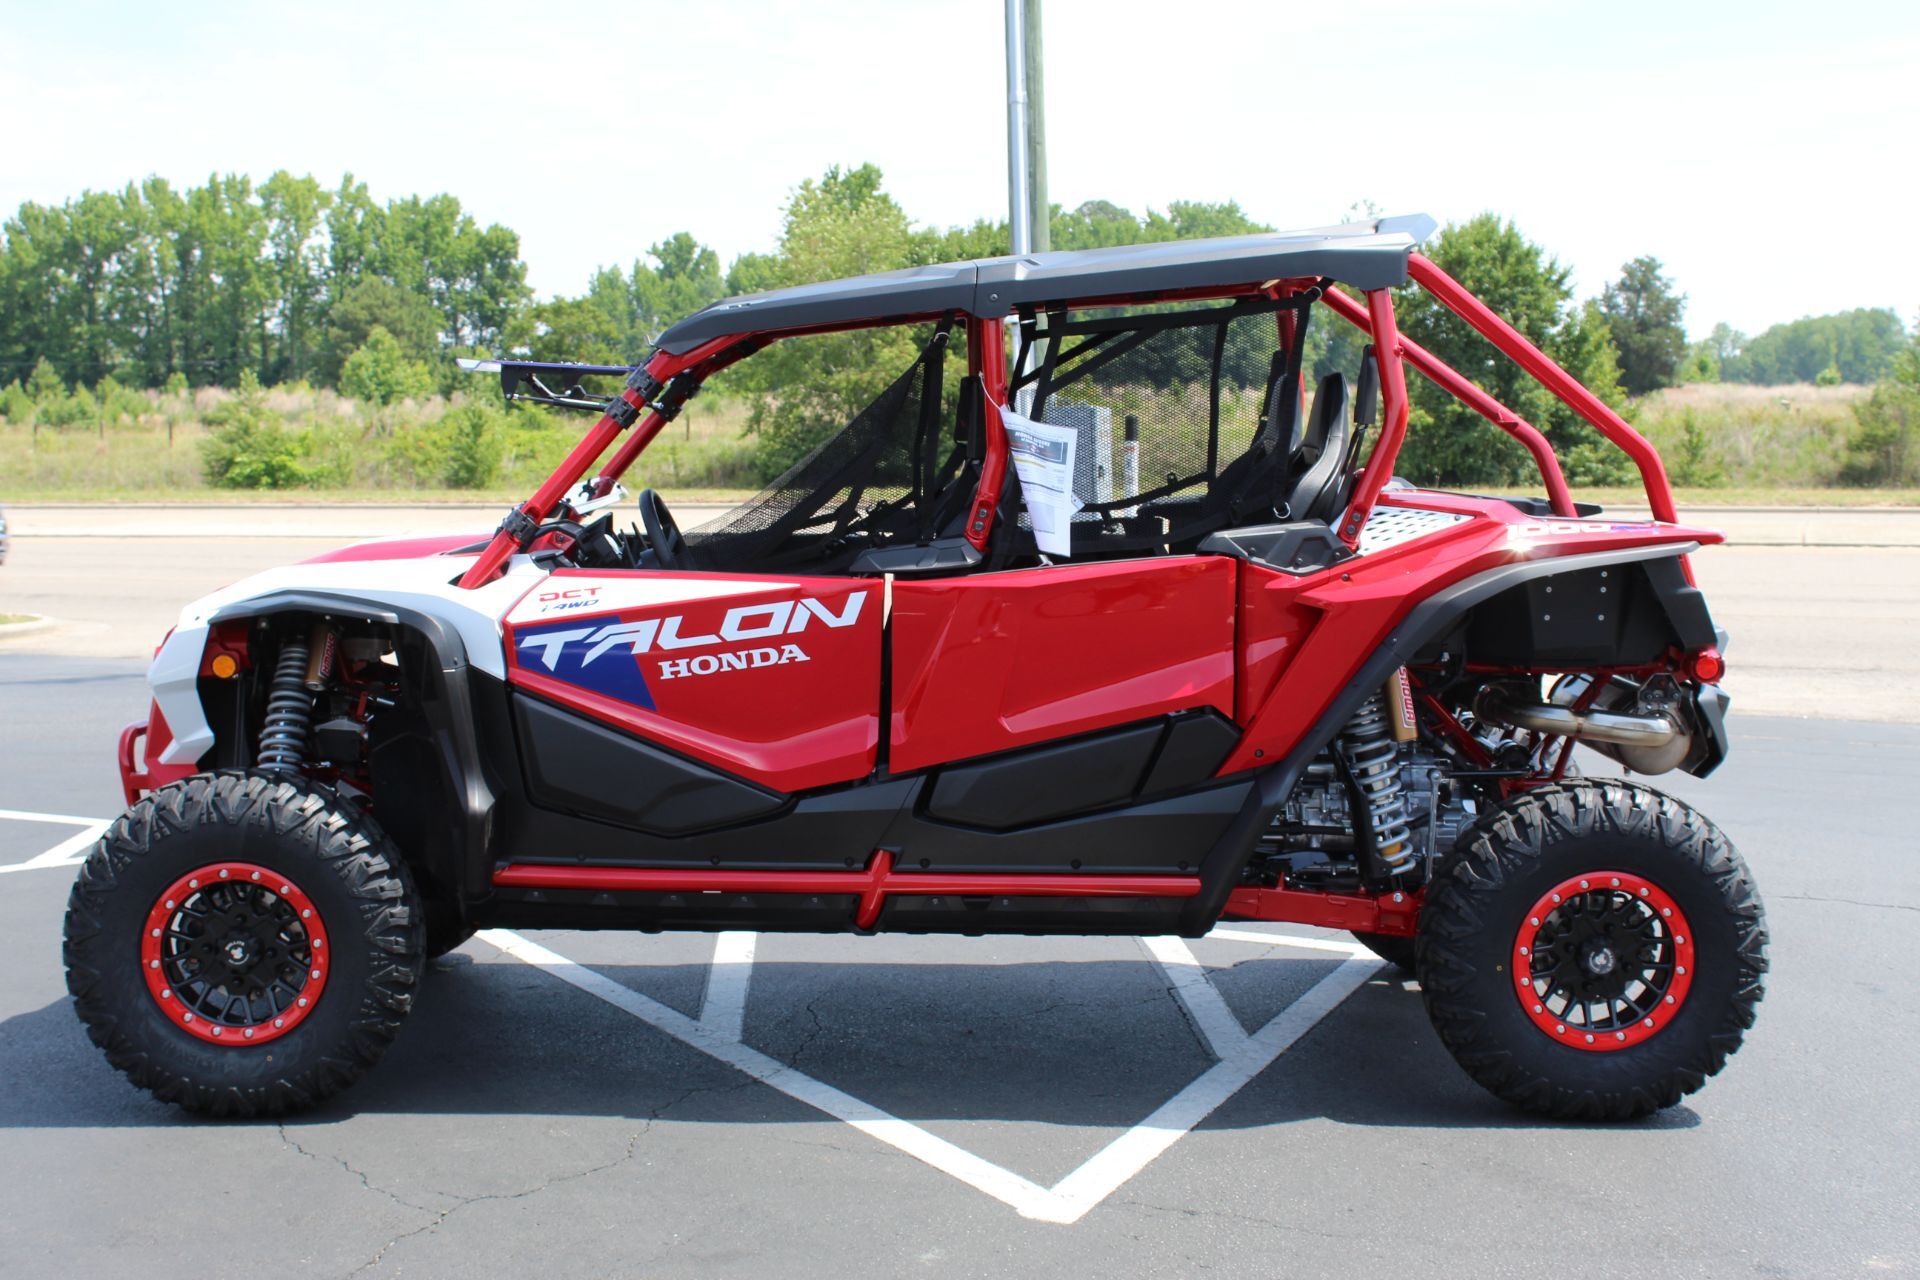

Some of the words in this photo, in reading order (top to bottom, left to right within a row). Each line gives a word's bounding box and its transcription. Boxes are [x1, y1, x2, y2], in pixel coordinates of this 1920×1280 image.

[539, 587, 602, 602] DCT
[519, 590, 868, 672] TALON
[658, 644, 811, 680] HONDA
[1399, 667, 1416, 721] SHOWA
